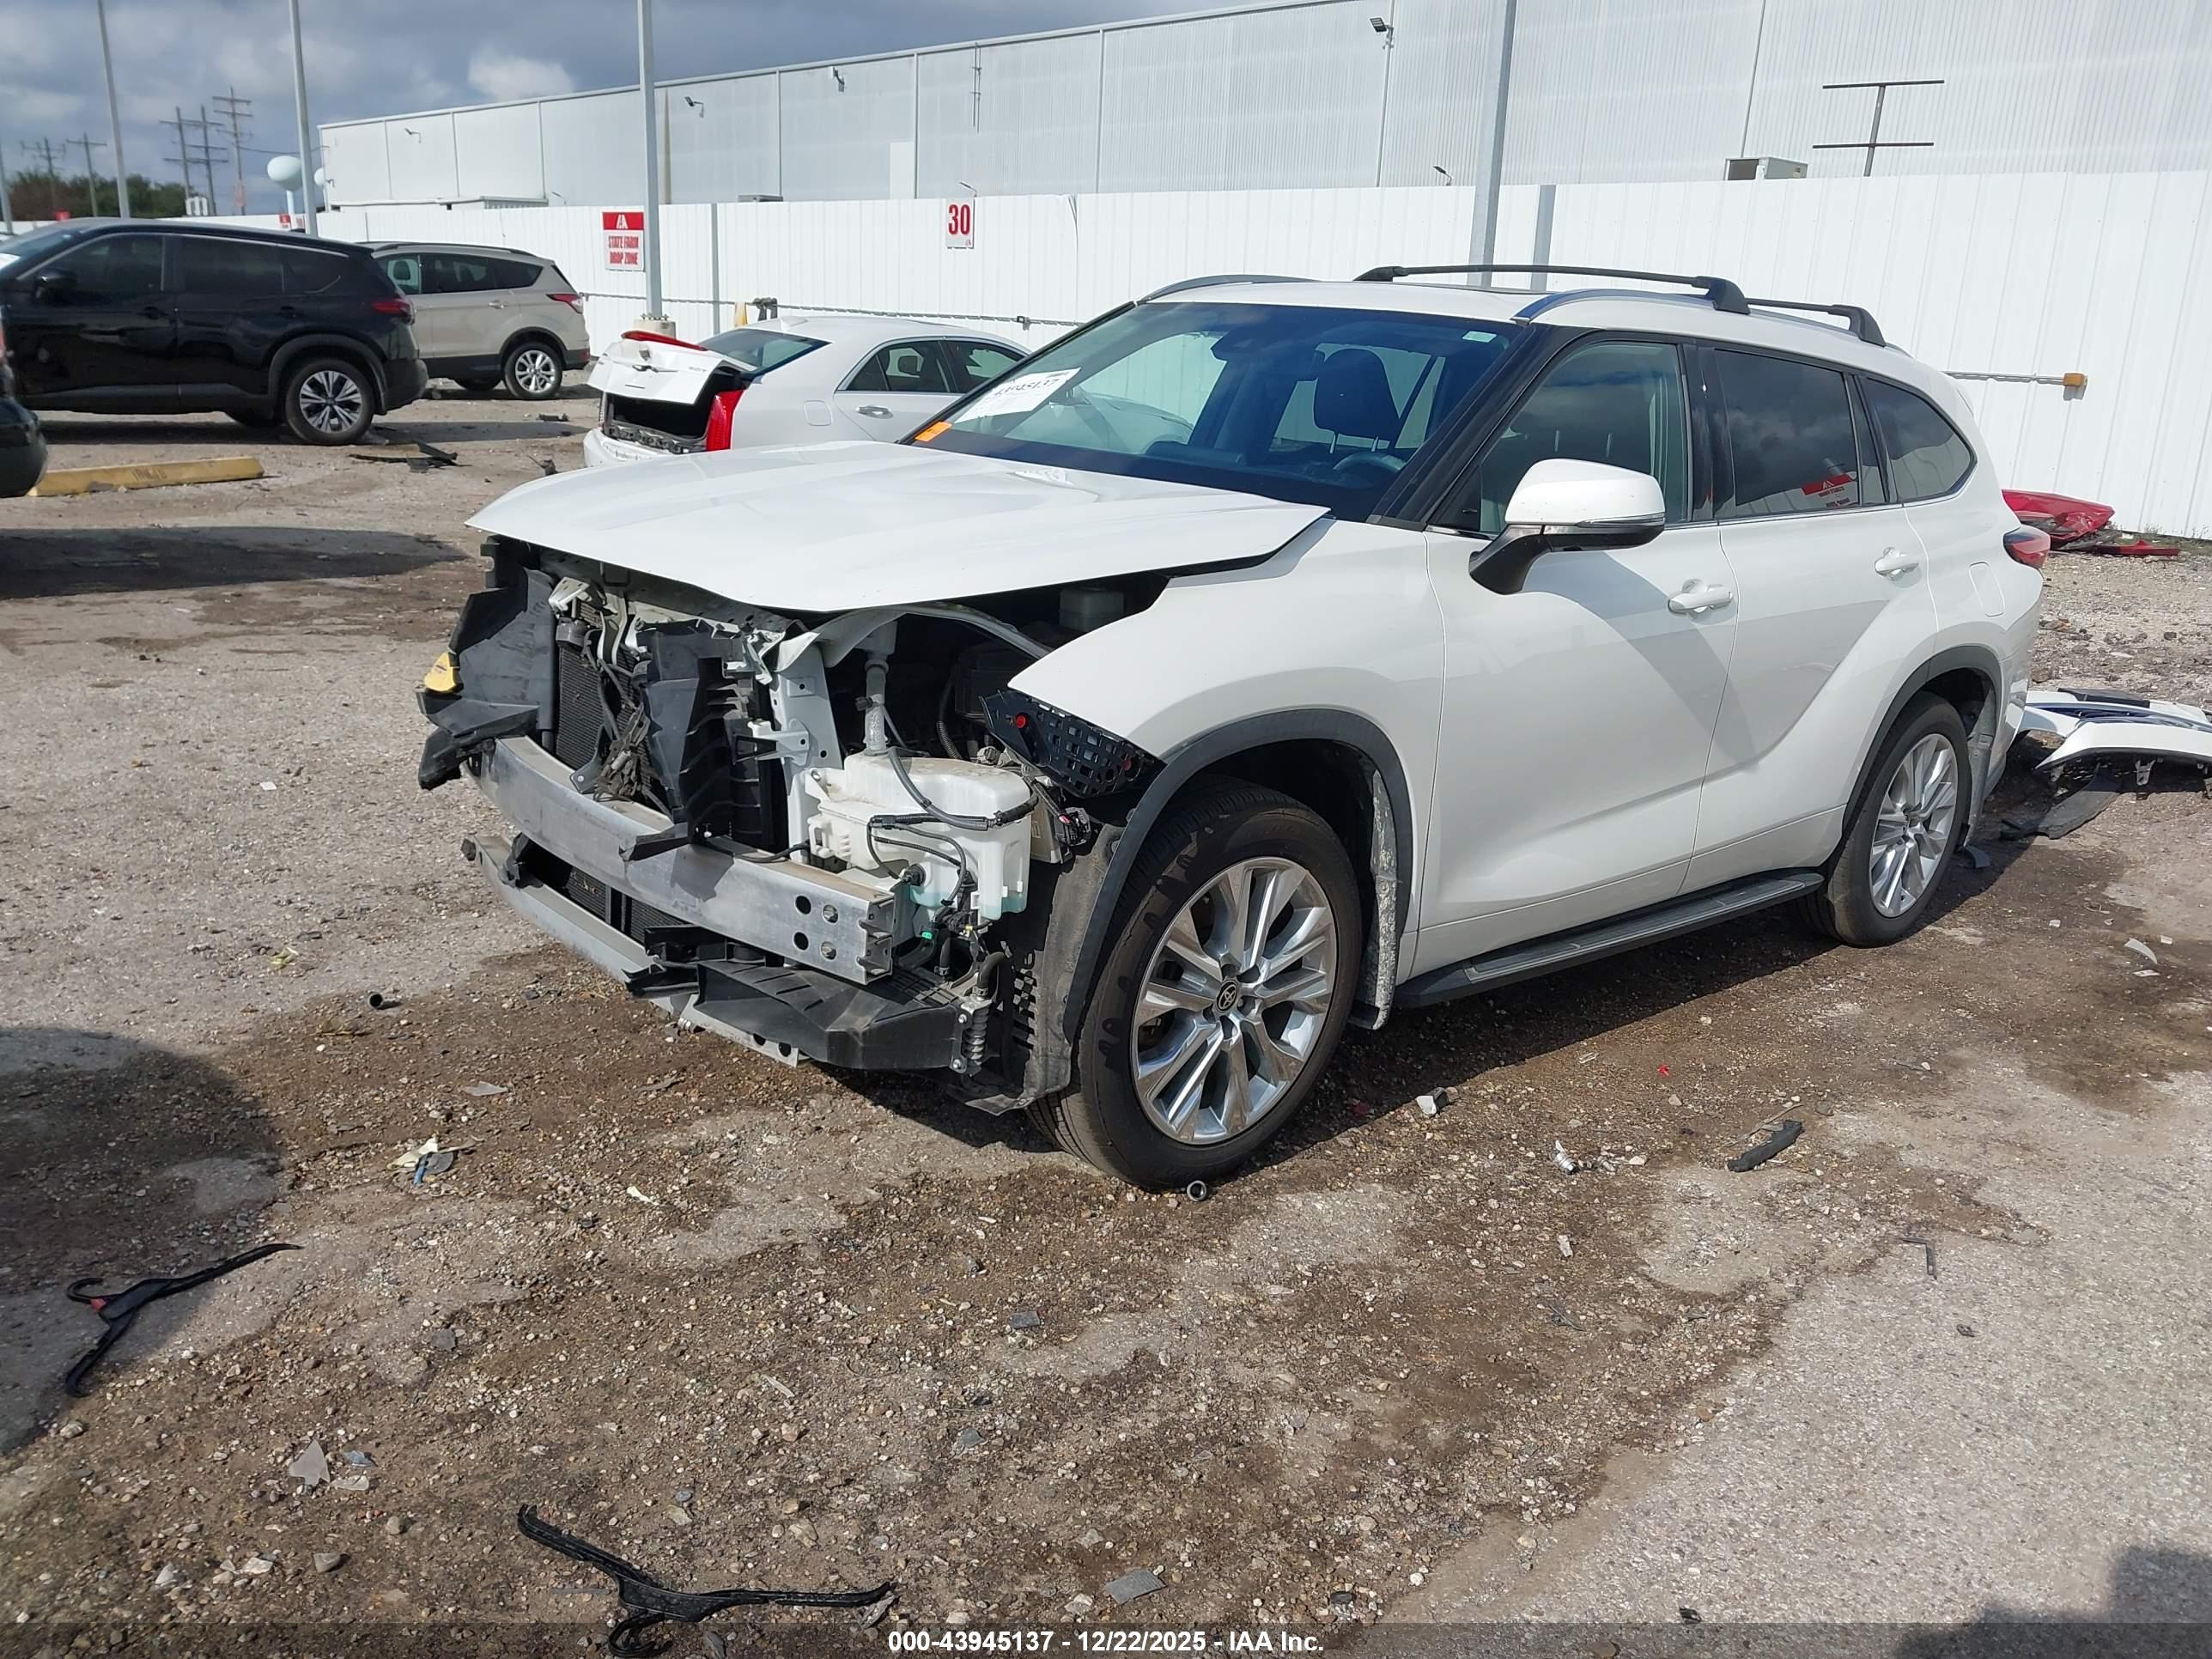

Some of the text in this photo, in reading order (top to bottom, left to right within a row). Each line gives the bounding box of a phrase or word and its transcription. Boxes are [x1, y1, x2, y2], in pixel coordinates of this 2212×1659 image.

[948, 204, 970, 235] 30
[608, 235, 639, 249] STATE FARM
[610, 251, 638, 264] DROP ZONE
